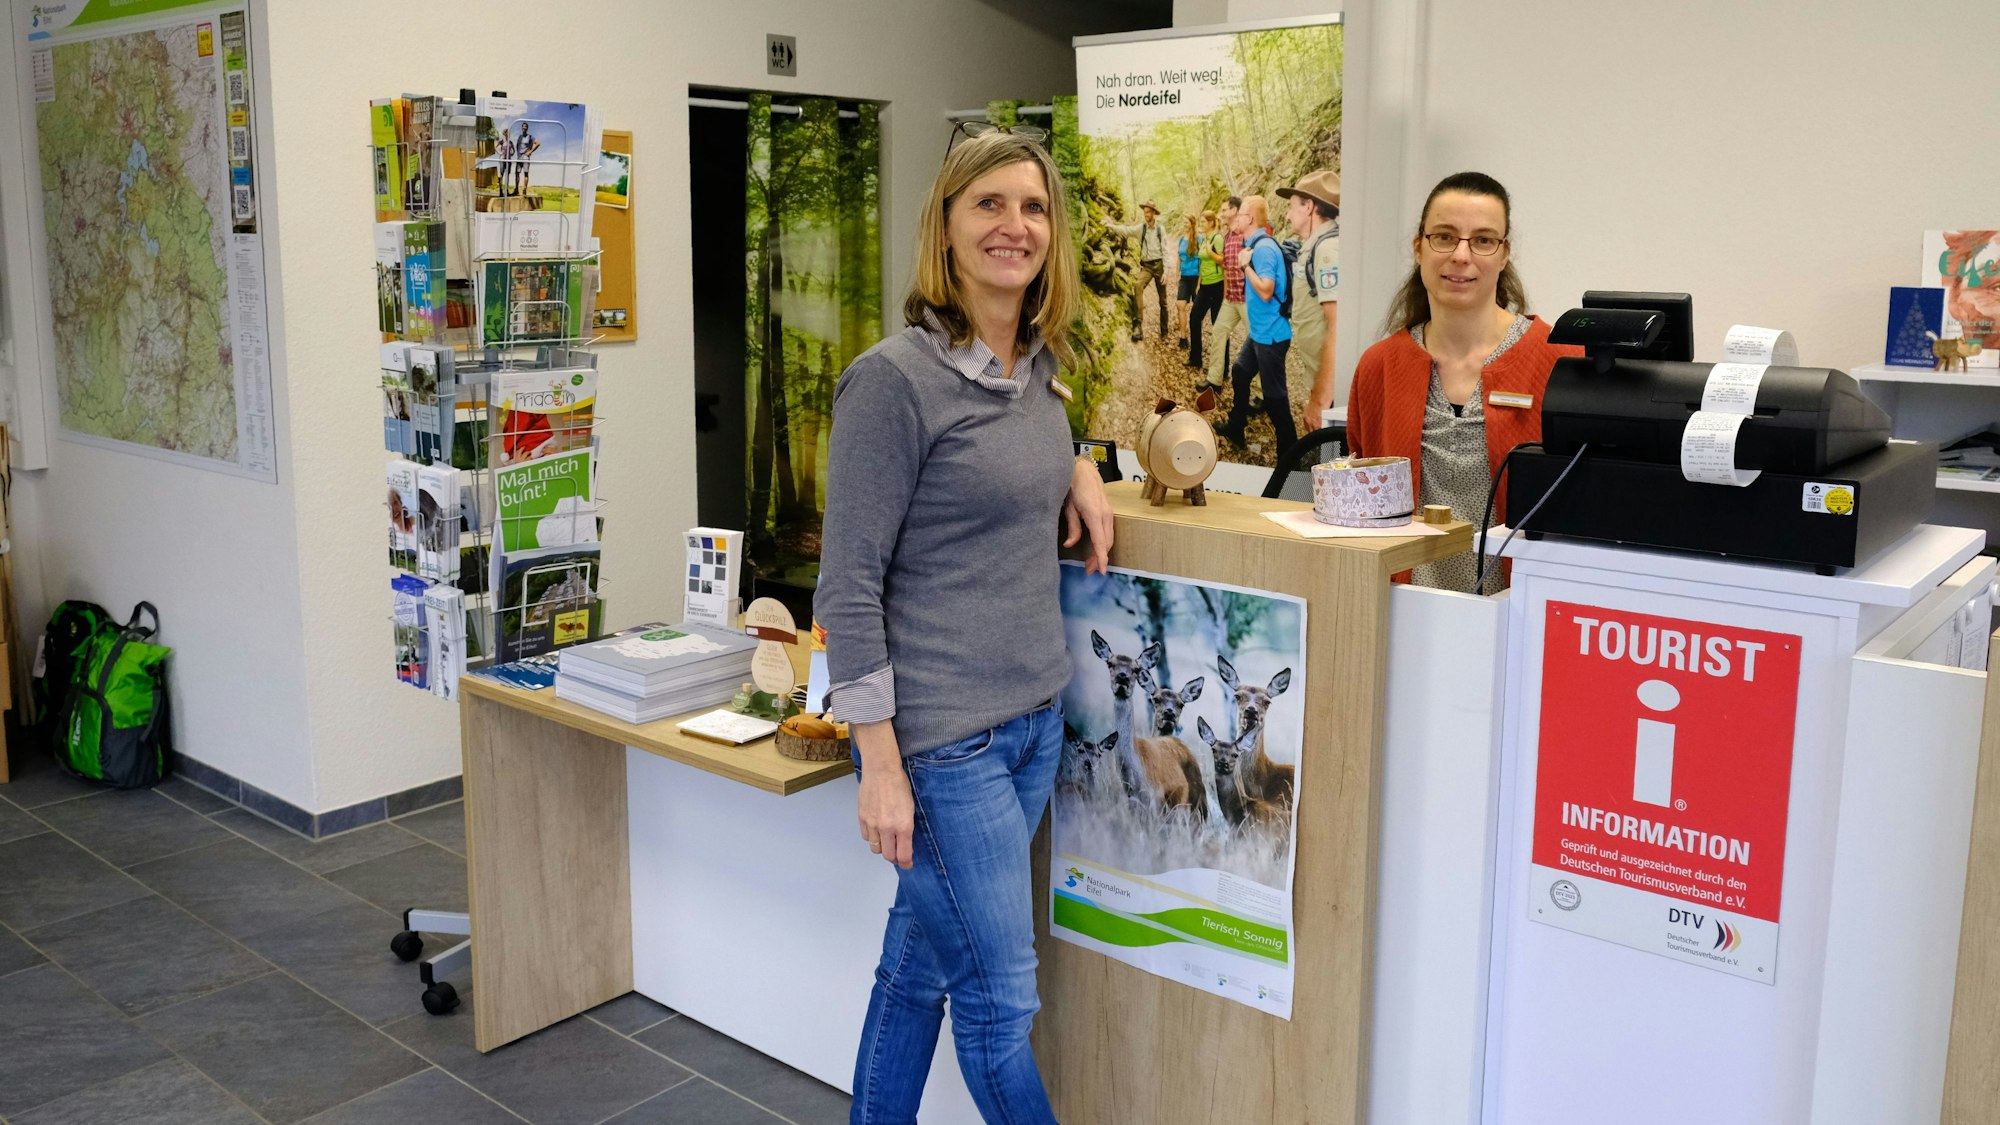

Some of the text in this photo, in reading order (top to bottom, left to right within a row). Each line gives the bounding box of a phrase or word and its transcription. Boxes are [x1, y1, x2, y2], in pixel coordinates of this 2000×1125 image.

[772, 58, 785, 68] WC
[1096, 67, 1222, 89] Nah dran. Weit weg!
[1096, 89, 1181, 109] Die Nordeifel
[1939, 242, 2000, 288] Eife
[500, 458, 579, 490] Mal mich
[501, 481, 547, 507] bunt!
[1572, 616, 1766, 682] TOURIST
[1561, 801, 1750, 866] INFORMATION
[1561, 838, 1747, 891] Geprüft und ausgezeichnet durch den
[1086, 875, 1132, 899] Nationalpark
[1086, 885, 1102, 897] Eifel
[1560, 853, 1746, 909] Deutschen Tourismusverband e.V.
[1669, 907, 1704, 929] DTV
[1202, 916, 1283, 950] Tierisch Sonnig
[1667, 932, 1699, 946] Deutscher
[1667, 941, 1739, 967] Tourismusverband e.V.
